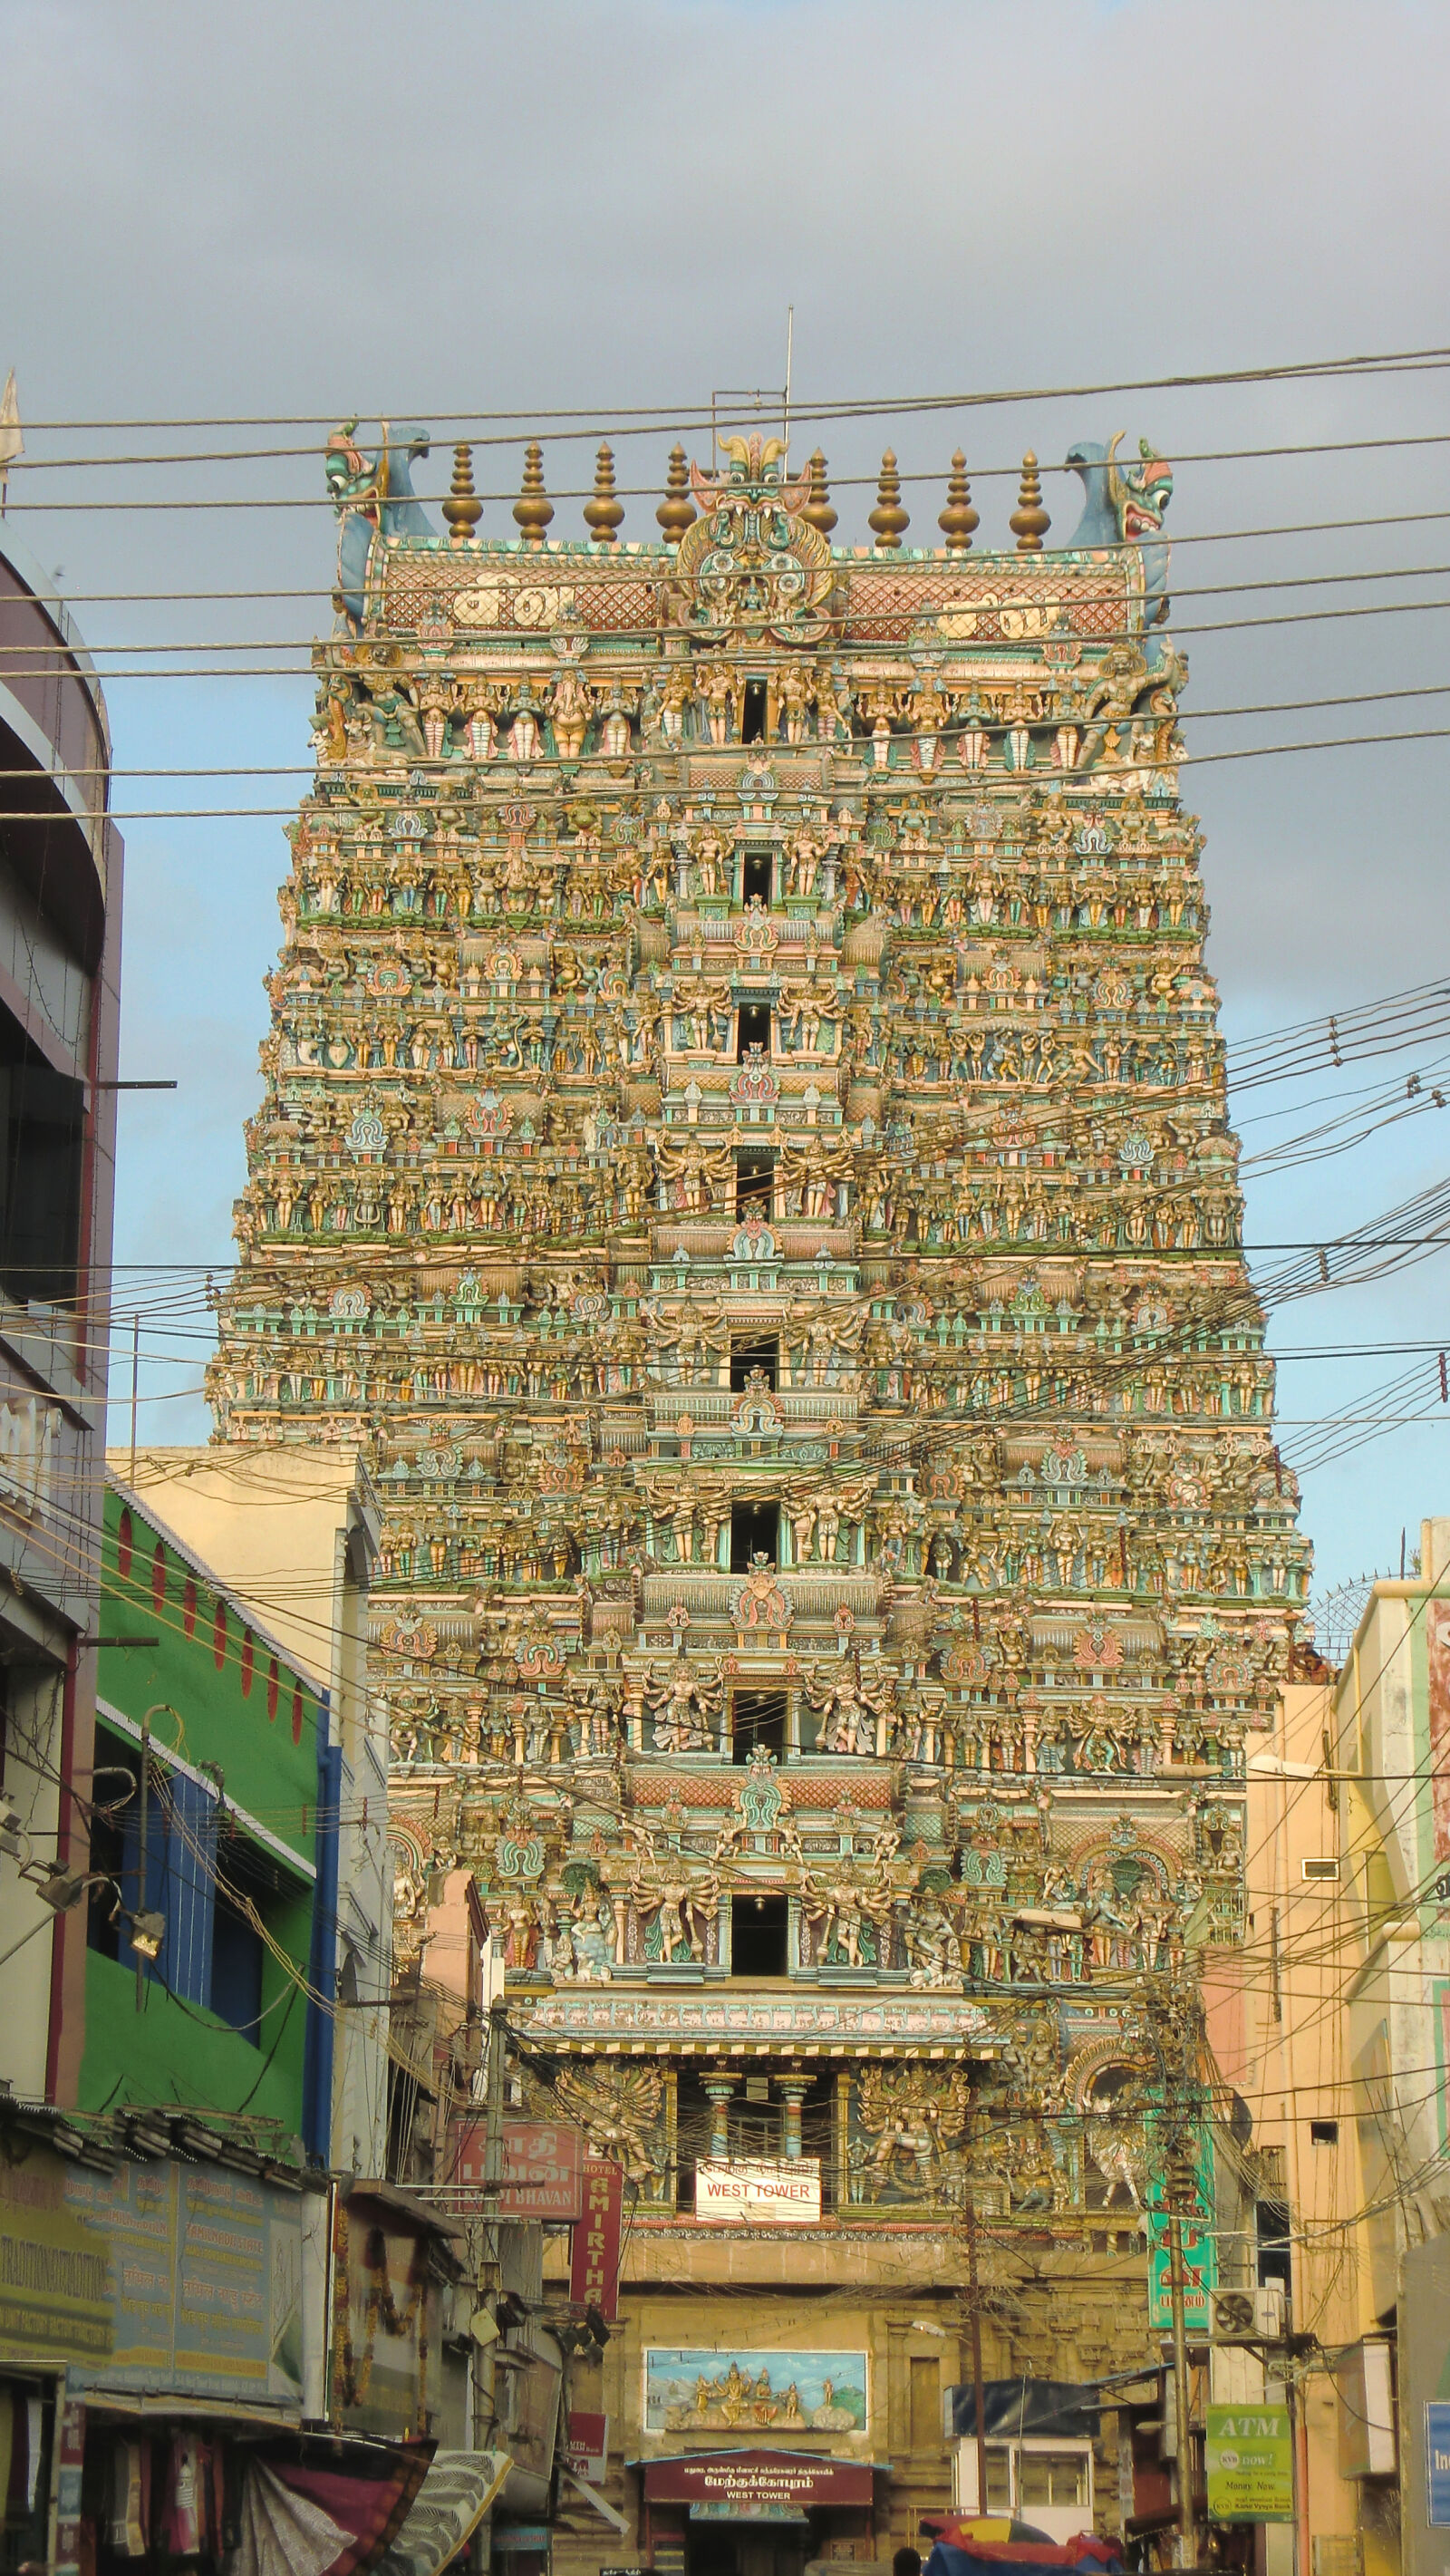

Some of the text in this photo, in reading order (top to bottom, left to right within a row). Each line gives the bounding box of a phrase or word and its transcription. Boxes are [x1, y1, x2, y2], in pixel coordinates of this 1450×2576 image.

[583, 2164, 618, 2175] HOTEL
[515, 2189, 572, 2206] BHAVAN
[707, 2184, 810, 2198] WEST TOWER
[584, 2177, 610, 2305] AMIRTHA
[1218, 2417, 1280, 2436] ATM
[726, 2491, 791, 2500] WEST TOWER
